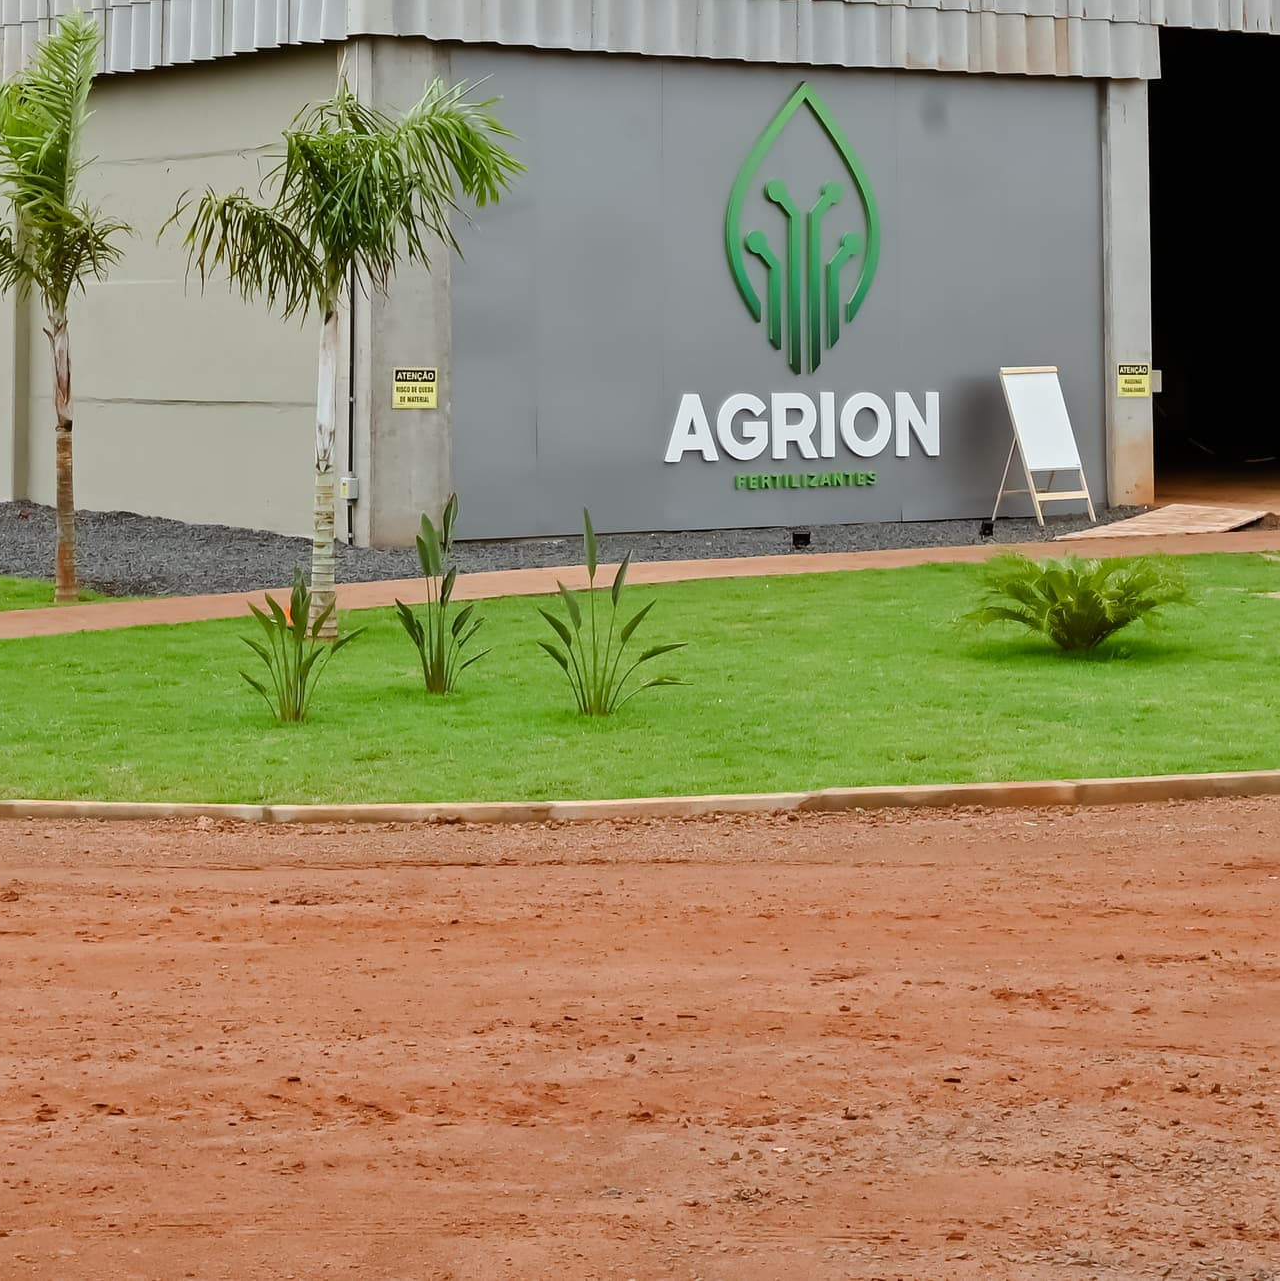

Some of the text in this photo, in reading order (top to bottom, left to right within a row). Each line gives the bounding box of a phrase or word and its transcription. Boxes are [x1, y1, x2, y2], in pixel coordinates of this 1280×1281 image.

[396, 371, 434, 381] ATENÇÃO
[1120, 366, 1147, 375] ATENÇÃO
[664, 391, 941, 463] AGRION
[735, 471, 878, 490] FERTILIZANTES
